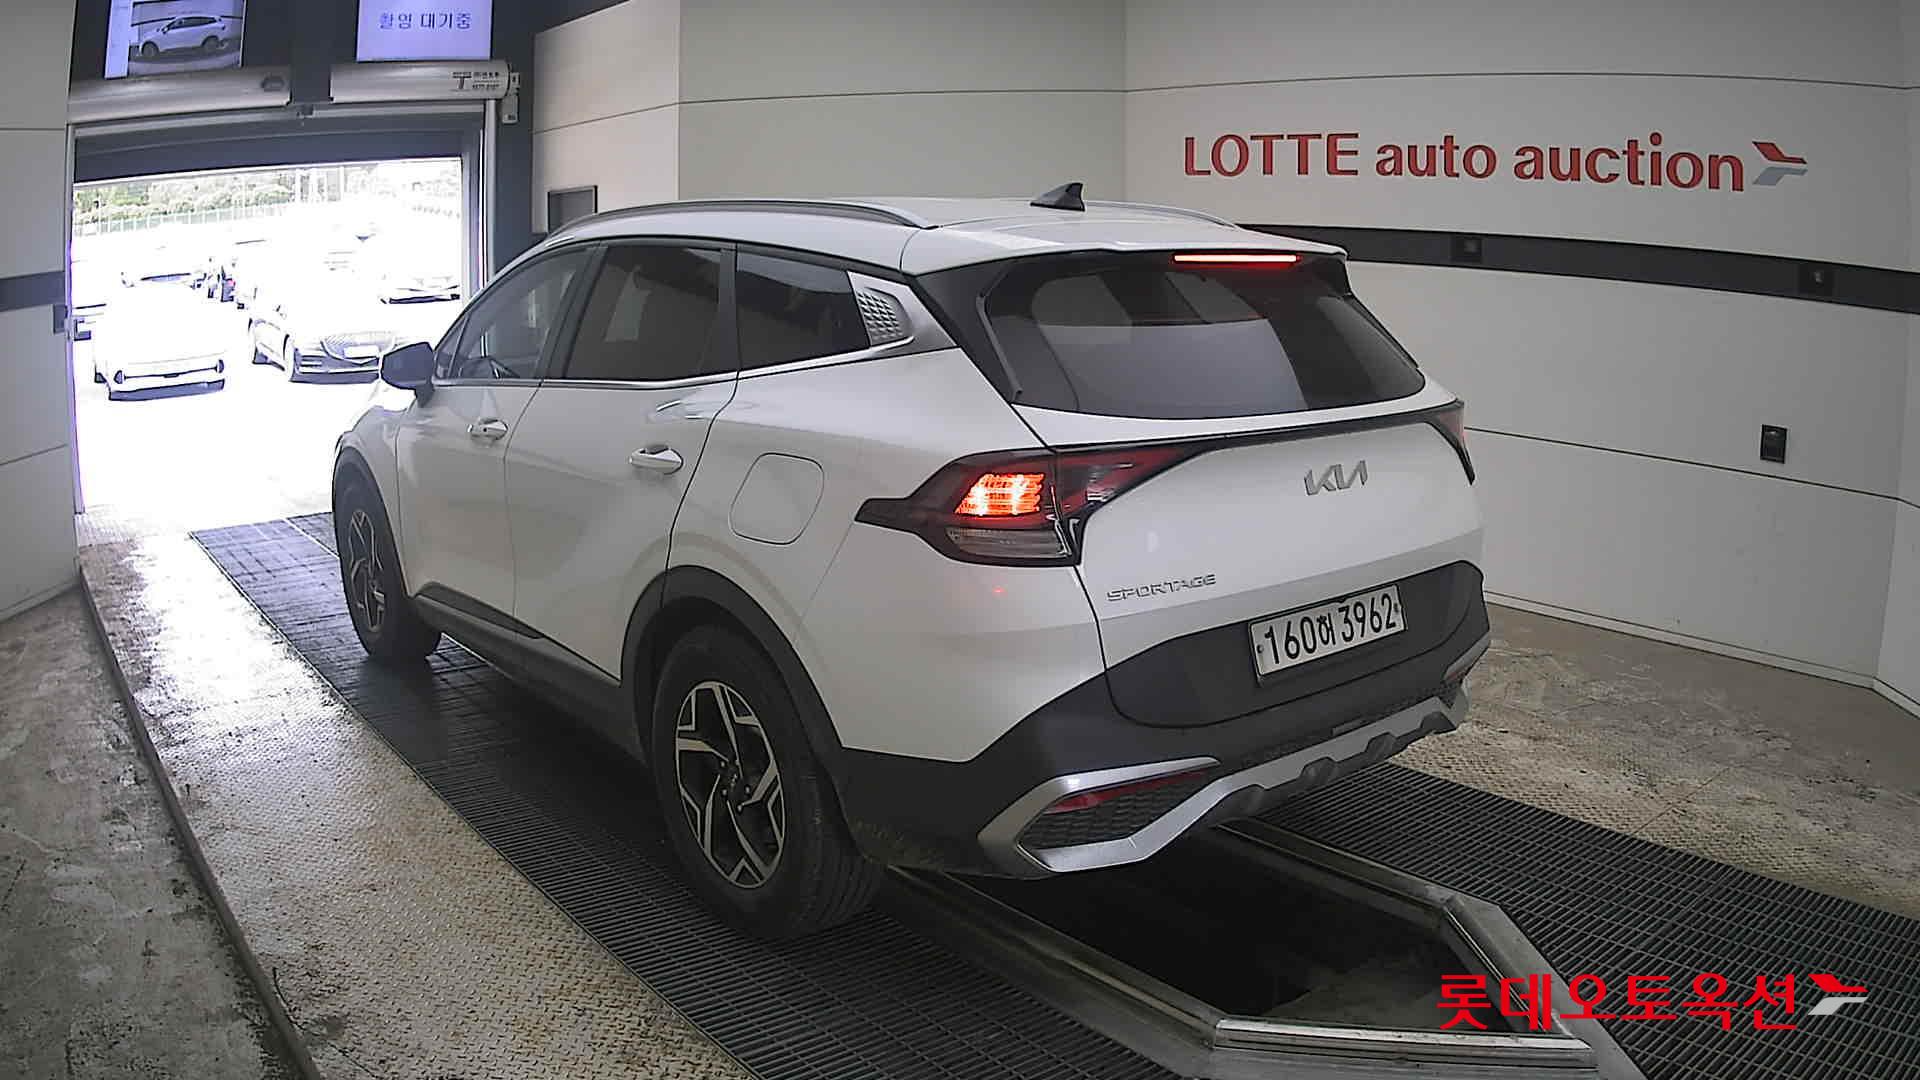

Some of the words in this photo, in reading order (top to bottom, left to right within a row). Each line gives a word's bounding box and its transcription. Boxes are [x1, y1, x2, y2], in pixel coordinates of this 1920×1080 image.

[420, 12, 472, 30] 대기중
[1184, 133, 1358, 177] LOTTE
[1376, 135, 1498, 178] auto
[1514, 132, 1744, 191] auction
[1106, 573, 1217, 602] SPORTAGE
